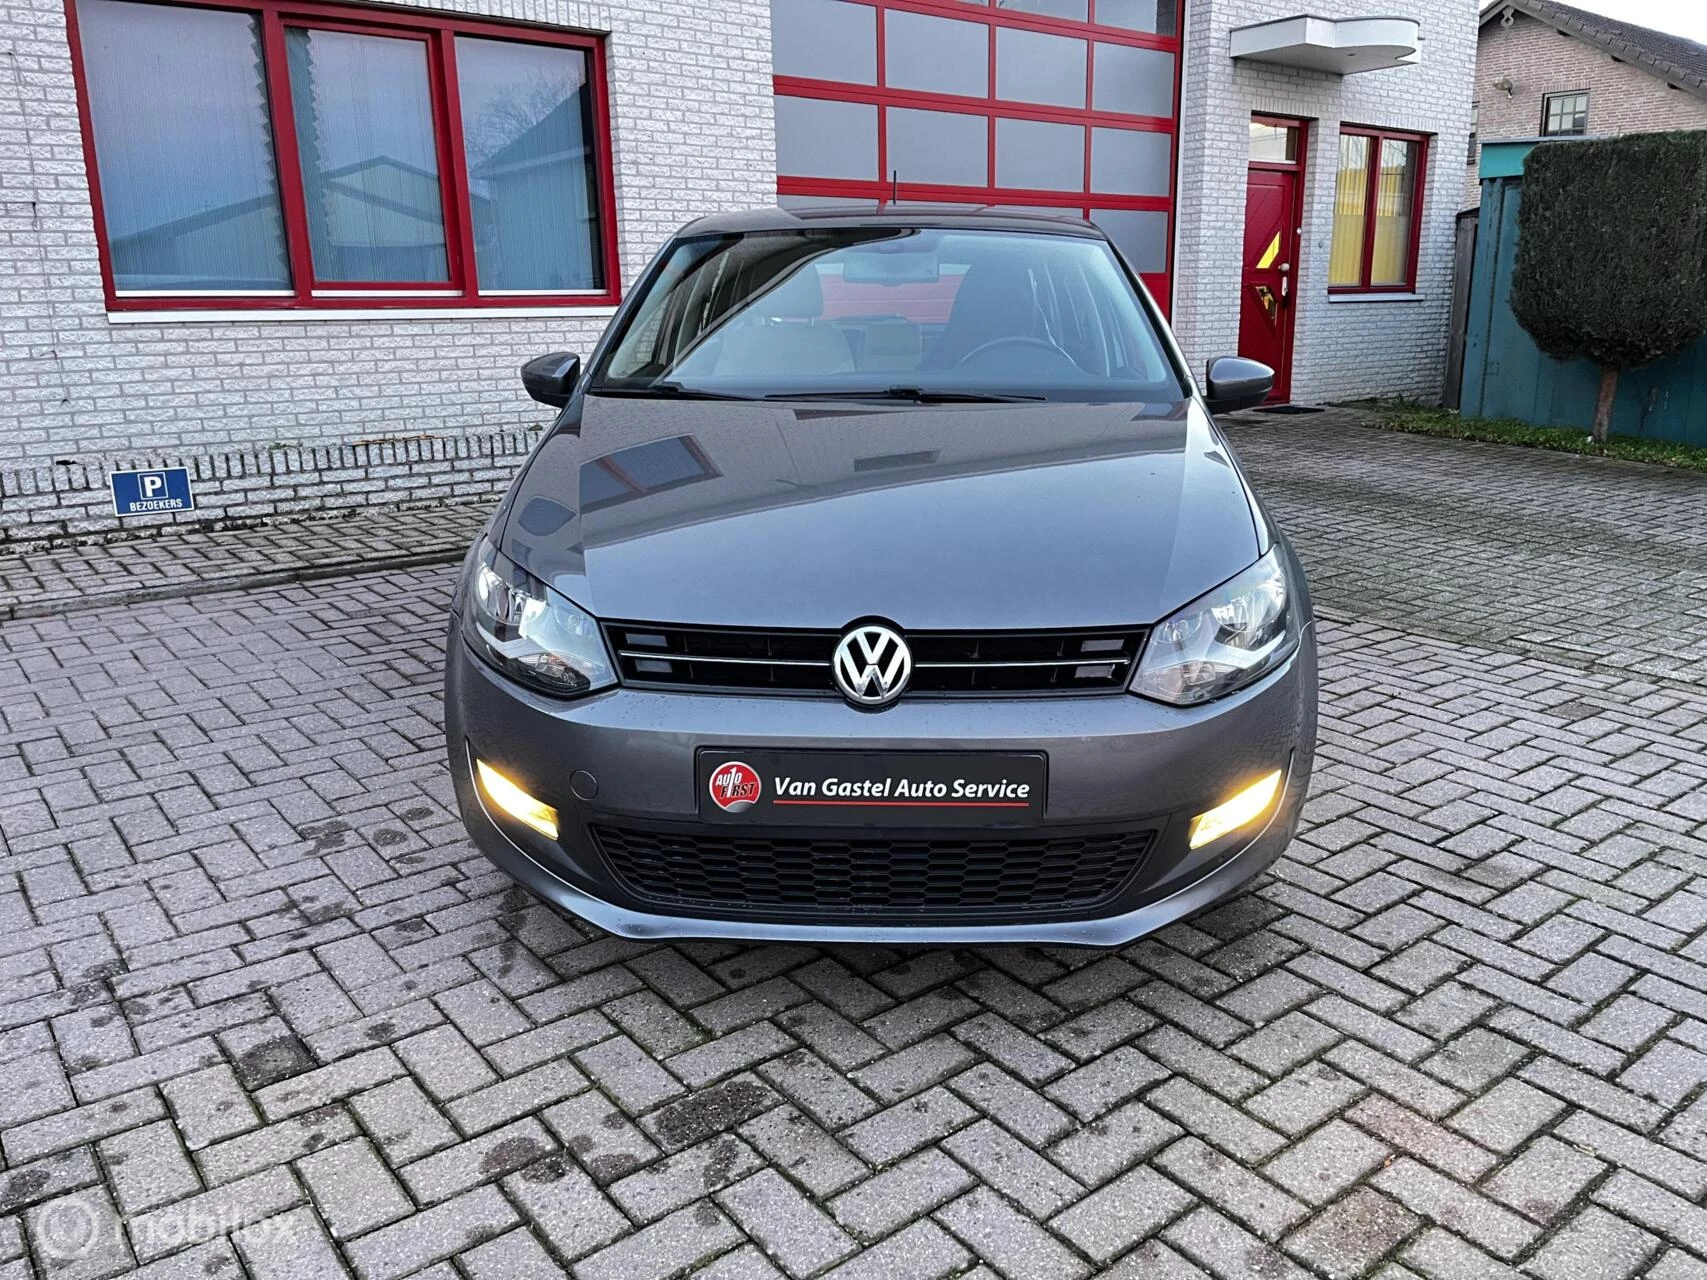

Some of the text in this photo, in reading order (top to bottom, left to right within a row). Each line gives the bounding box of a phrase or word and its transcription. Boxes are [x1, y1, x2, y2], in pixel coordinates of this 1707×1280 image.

[143, 476, 162, 497] P
[129, 499, 183, 512] BEZOEKERS
[774, 776, 1030, 798] Van Gastel Auto Service
